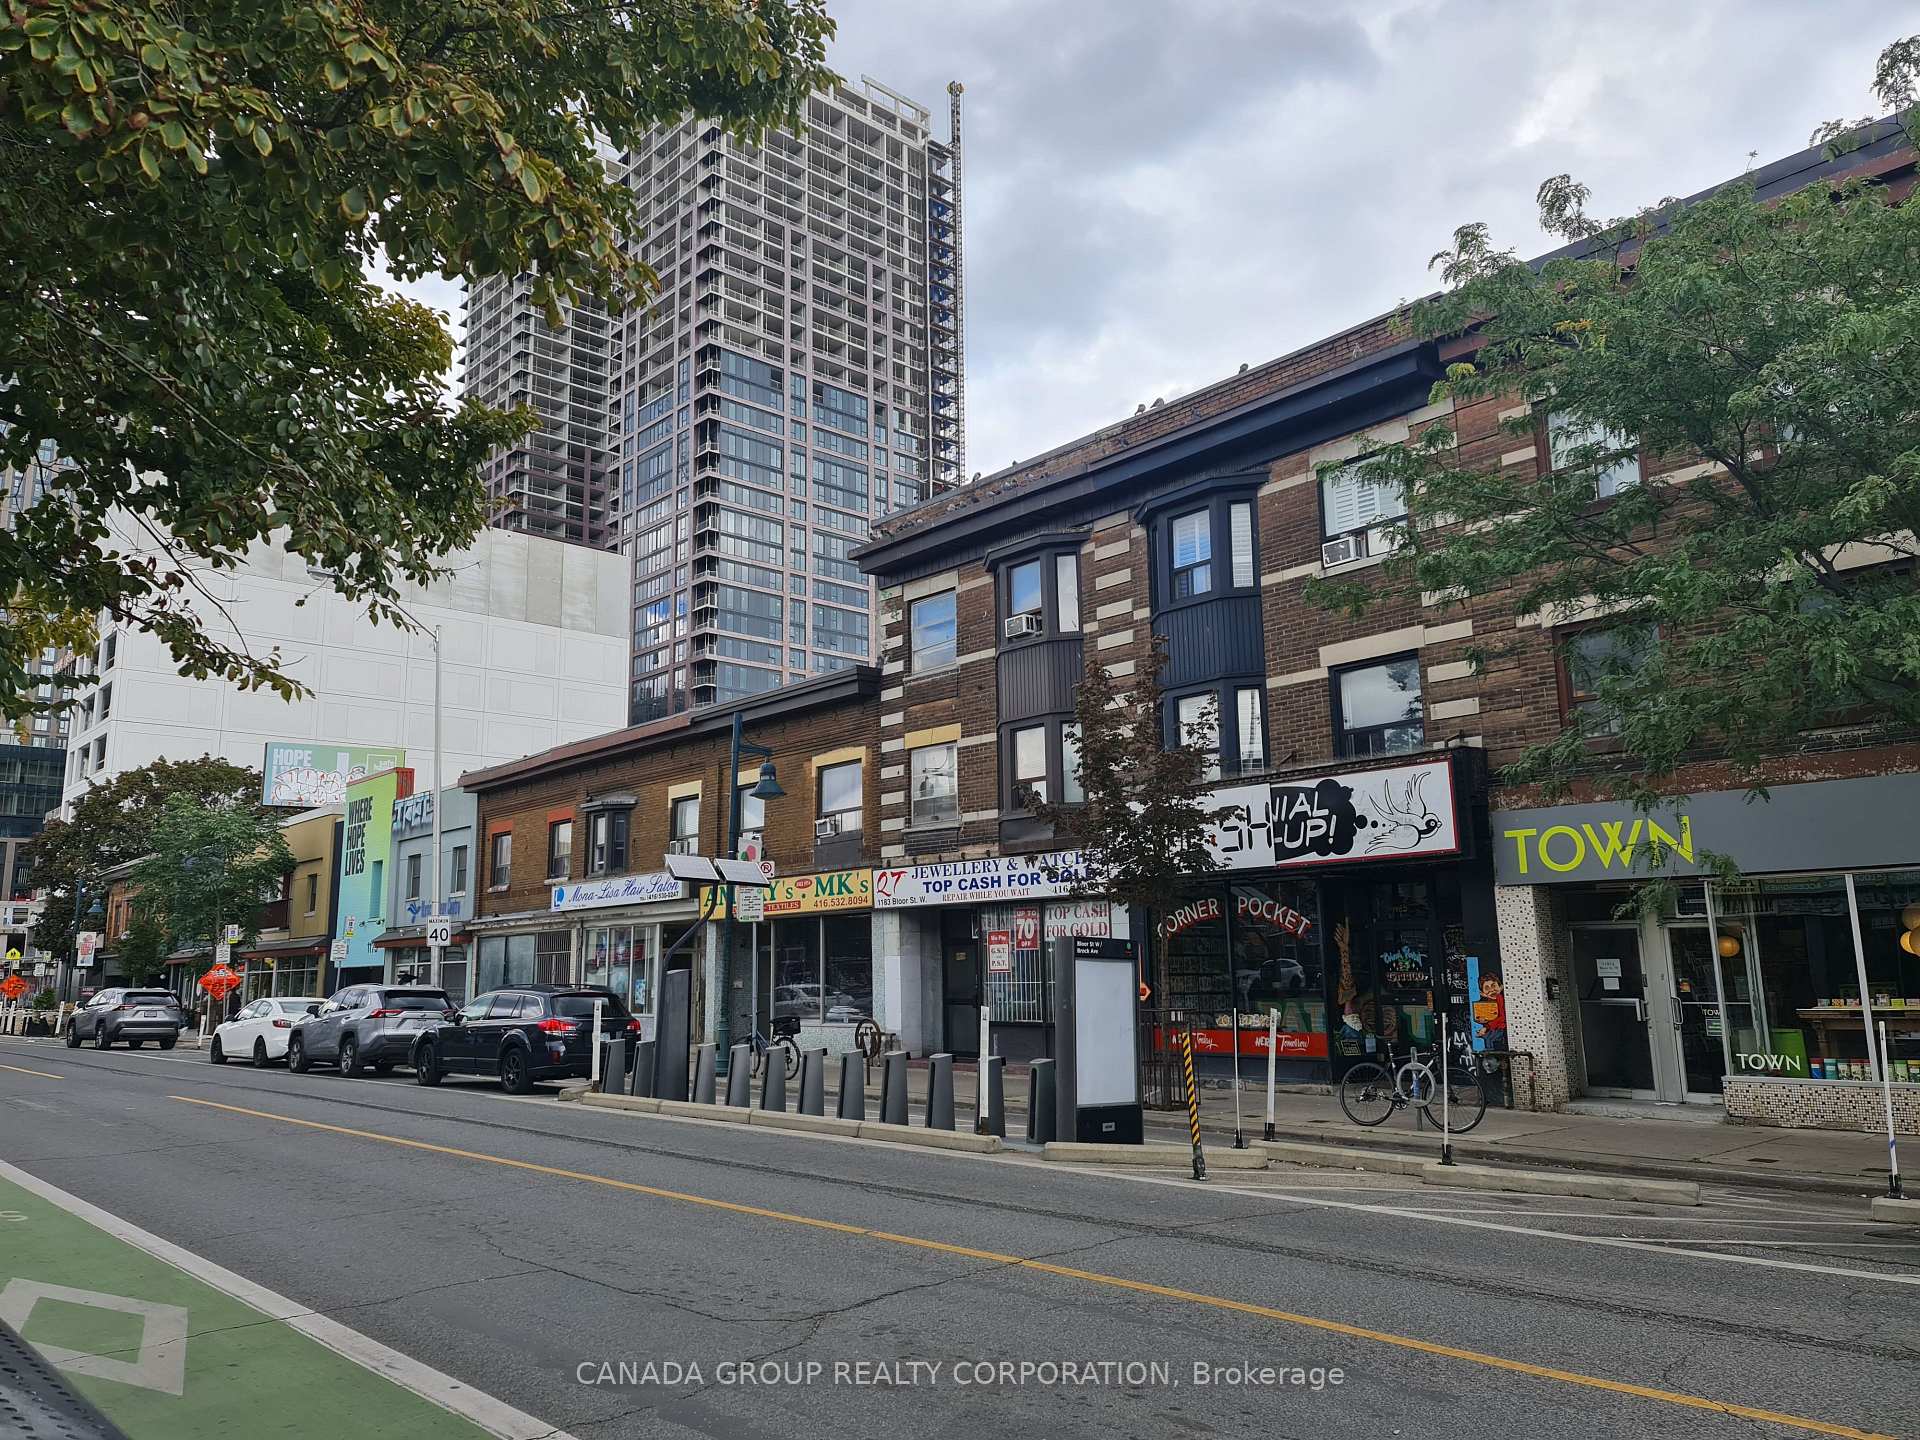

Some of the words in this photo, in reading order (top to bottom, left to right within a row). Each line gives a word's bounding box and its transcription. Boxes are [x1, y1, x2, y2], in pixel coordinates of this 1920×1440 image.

[272, 748, 313, 768] HOPE
[348, 796, 374, 826] WHERE
[346, 823, 367, 851] HOPE
[1503, 814, 1695, 875] TOWN
[344, 849, 366, 877] LIVES
[911, 859, 1002, 880] JEWELLERY
[1006, 857, 1019, 871] &
[569, 881, 620, 903] Mona-Lisa
[620, 879, 645, 898] Hair
[645, 873, 680, 894] Salon
[814, 871, 869, 898] MK's
[922, 879, 953, 894] TOP
[957, 875, 1002, 891] CASH
[1006, 872, 1042, 888] FOR
[813, 896, 869, 909] 416.532.8094
[891, 896, 910, 905] Bloor
[919, 895, 928, 903] W.
[941, 891, 969, 903] REPAIR
[969, 890, 992, 901] WHILE
[992, 889, 1010, 900] YOU
[1010, 887, 1032, 898] WAIT
[1045, 905, 1072, 920] TOP
[1073, 900, 1109, 918] CASH
[1157, 898, 1220, 939] CORNER
[1237, 896, 1311, 935] POCKET
[429, 928, 449, 942] 40
[1045, 924, 1067, 938] FOR
[1070, 921, 1109, 937] GOLD
[1735, 1053, 1801, 1072] TOWN
